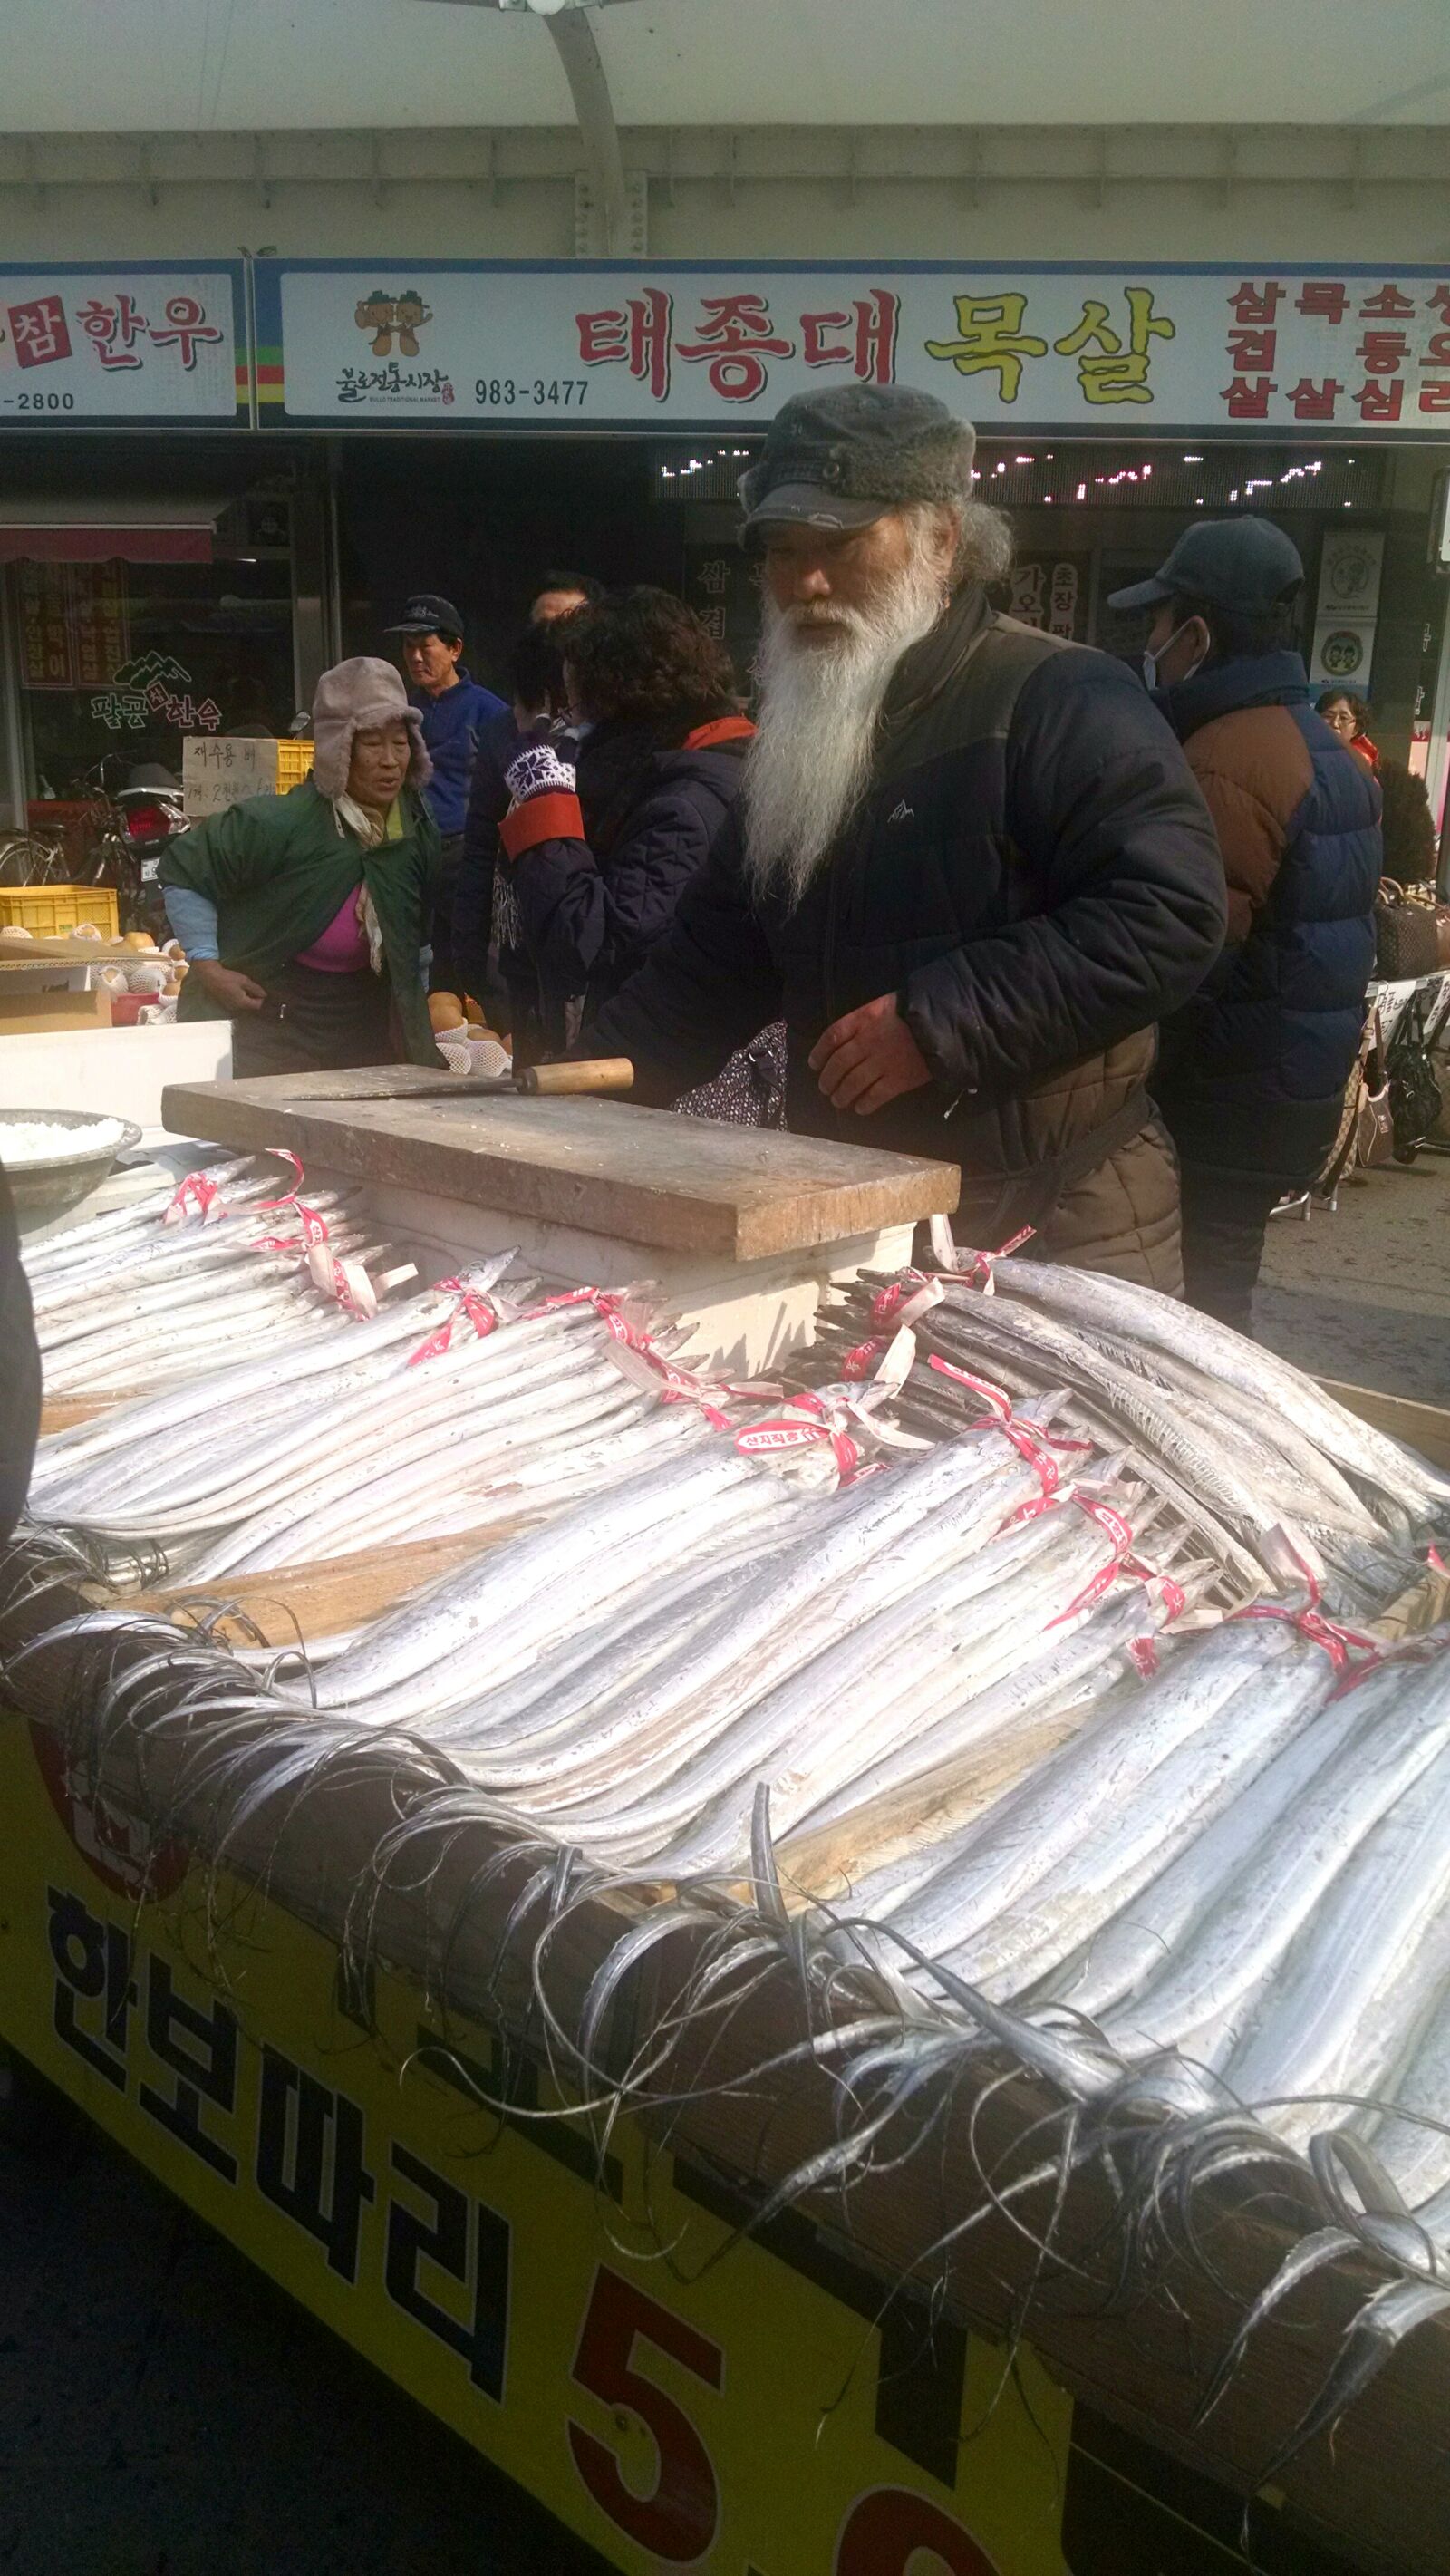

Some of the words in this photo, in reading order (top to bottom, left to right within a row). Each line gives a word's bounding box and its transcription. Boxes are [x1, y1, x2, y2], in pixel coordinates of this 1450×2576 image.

[475, 379, 589, 405] 983-3477
[575, 287, 901, 403] 태종대
[924, 286, 1176, 404] 목살
[1219, 282, 1287, 419] 삼겹살
[1285, 282, 1351, 421] 목살
[1350, 284, 1416, 421] 소등심
